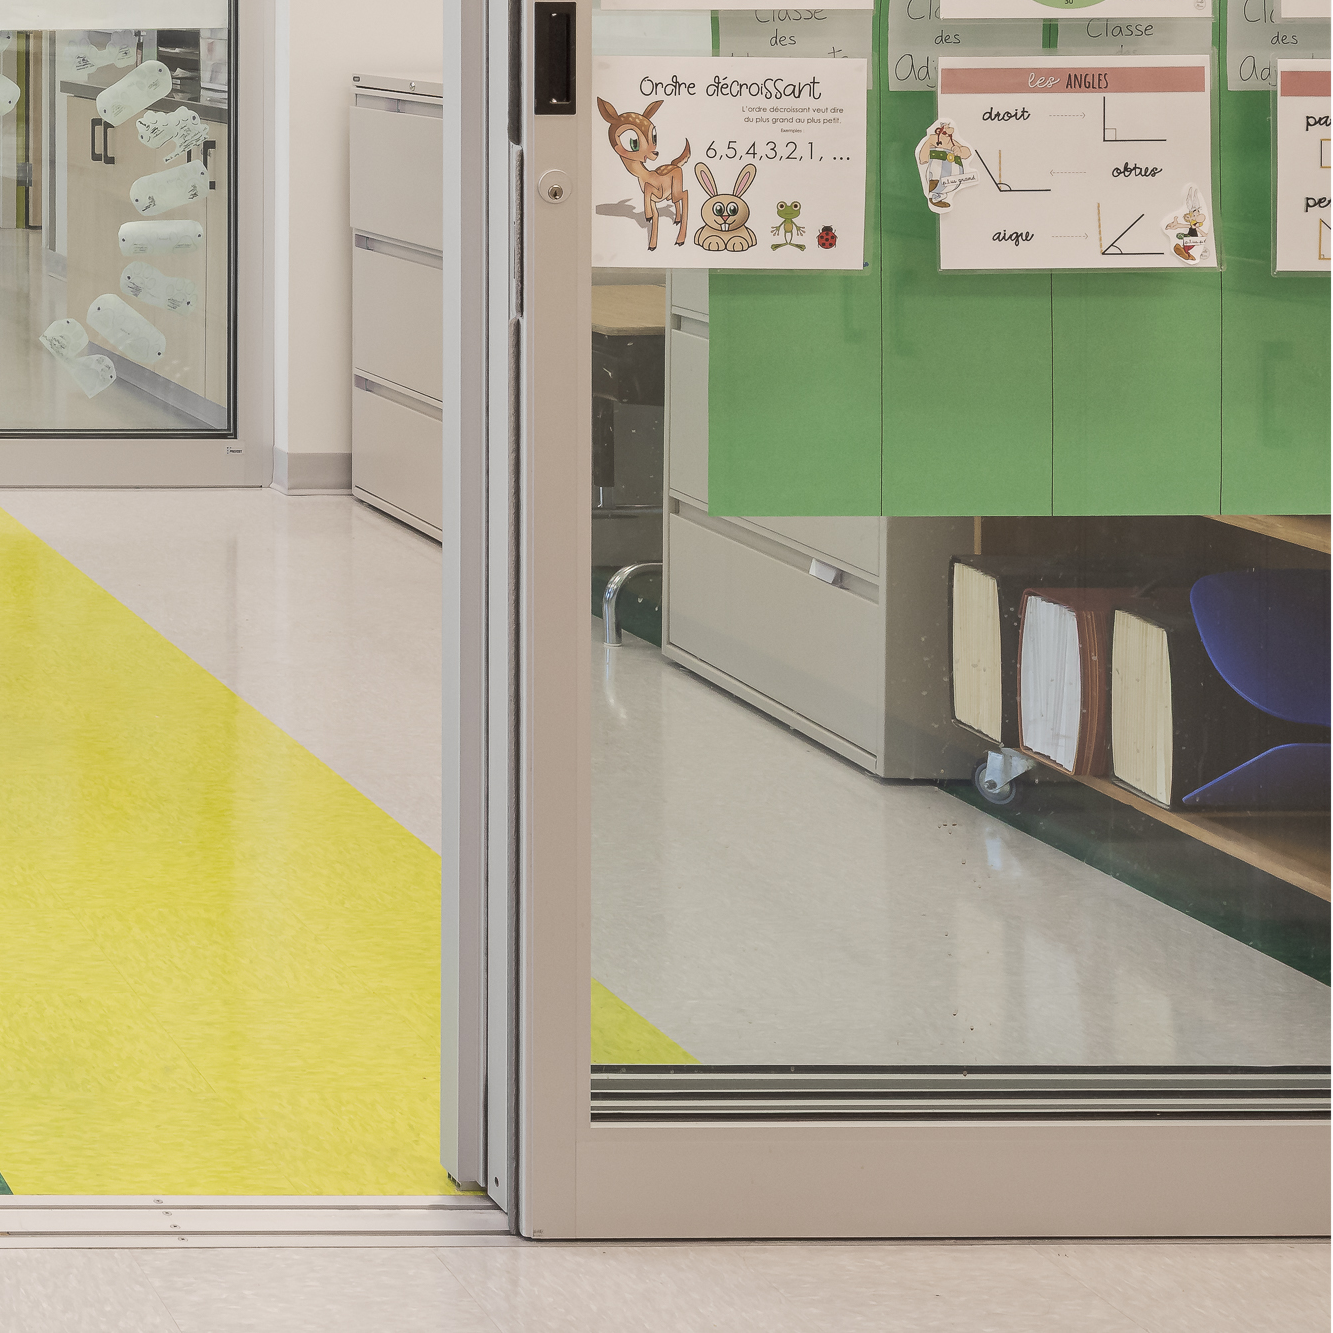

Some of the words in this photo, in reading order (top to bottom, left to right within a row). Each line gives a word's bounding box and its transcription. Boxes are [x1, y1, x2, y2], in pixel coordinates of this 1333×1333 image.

[769, 28, 797, 47] des
[934, 29, 961, 46] des
[1270, 31, 1299, 45] des
[640, 75, 696, 96] Ordre
[1029, 73, 1061, 88] les
[1066, 73, 1108, 89] ANGLES
[982, 107, 1031, 122] droit
[1111, 162, 1163, 179] obtus
